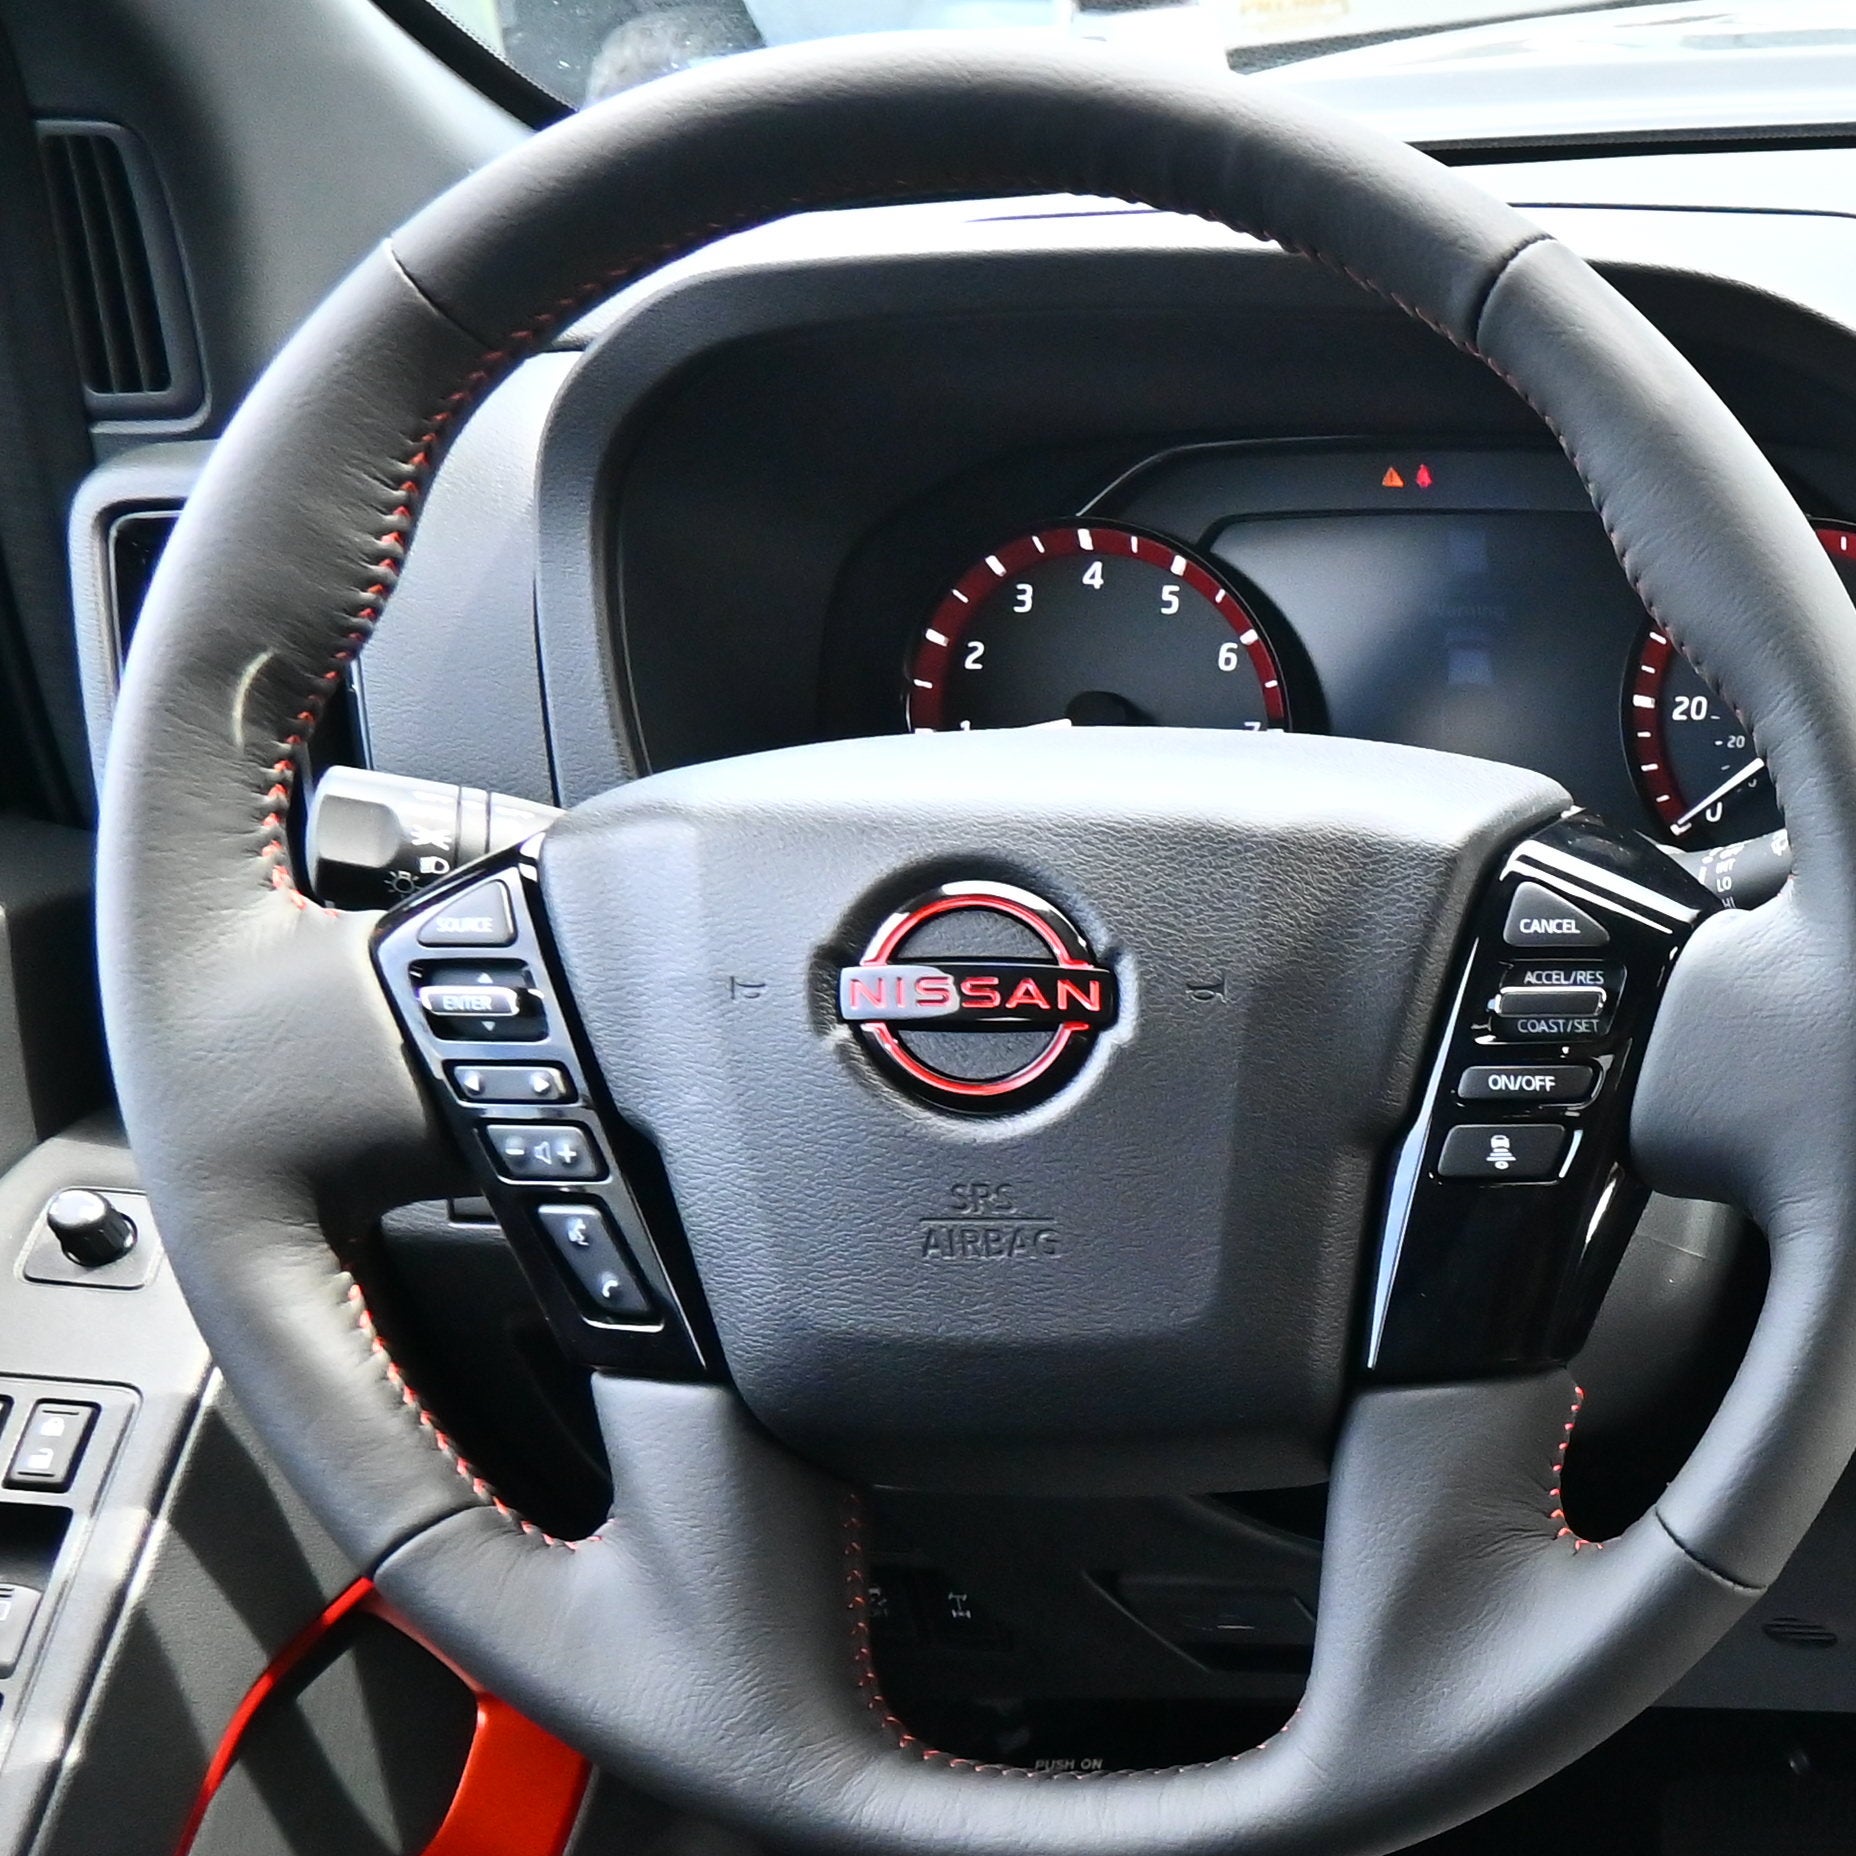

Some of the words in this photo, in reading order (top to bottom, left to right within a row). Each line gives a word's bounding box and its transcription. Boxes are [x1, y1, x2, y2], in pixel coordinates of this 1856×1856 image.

[1082, 561, 1105, 589] 4
[1013, 584, 1034, 613] 3
[1160, 585, 1180, 615] 5
[964, 641, 985, 670] 2
[1217, 642, 1238, 672] 6
[1672, 696, 1708, 721] 20
[1727, 735, 1746, 749] 20
[1717, 876, 1732, 893] LO
[436, 917, 494, 933] SOURCE
[1519, 918, 1581, 935] CANCEL
[1523, 970, 1604, 985] ACCEL/RES
[443, 995, 492, 1011] ENTER
[848, 975, 1102, 1012] NISSAN
[1517, 1017, 1598, 1034] COAST/SET
[1487, 1075, 1556, 1092] ON/OFF
[950, 1183, 1017, 1214] SRS
[920, 1226, 1064, 1261] AIRBAG
[1035, 1758, 1075, 1770] PUSH
[1080, 1758, 1103, 1770] ON
